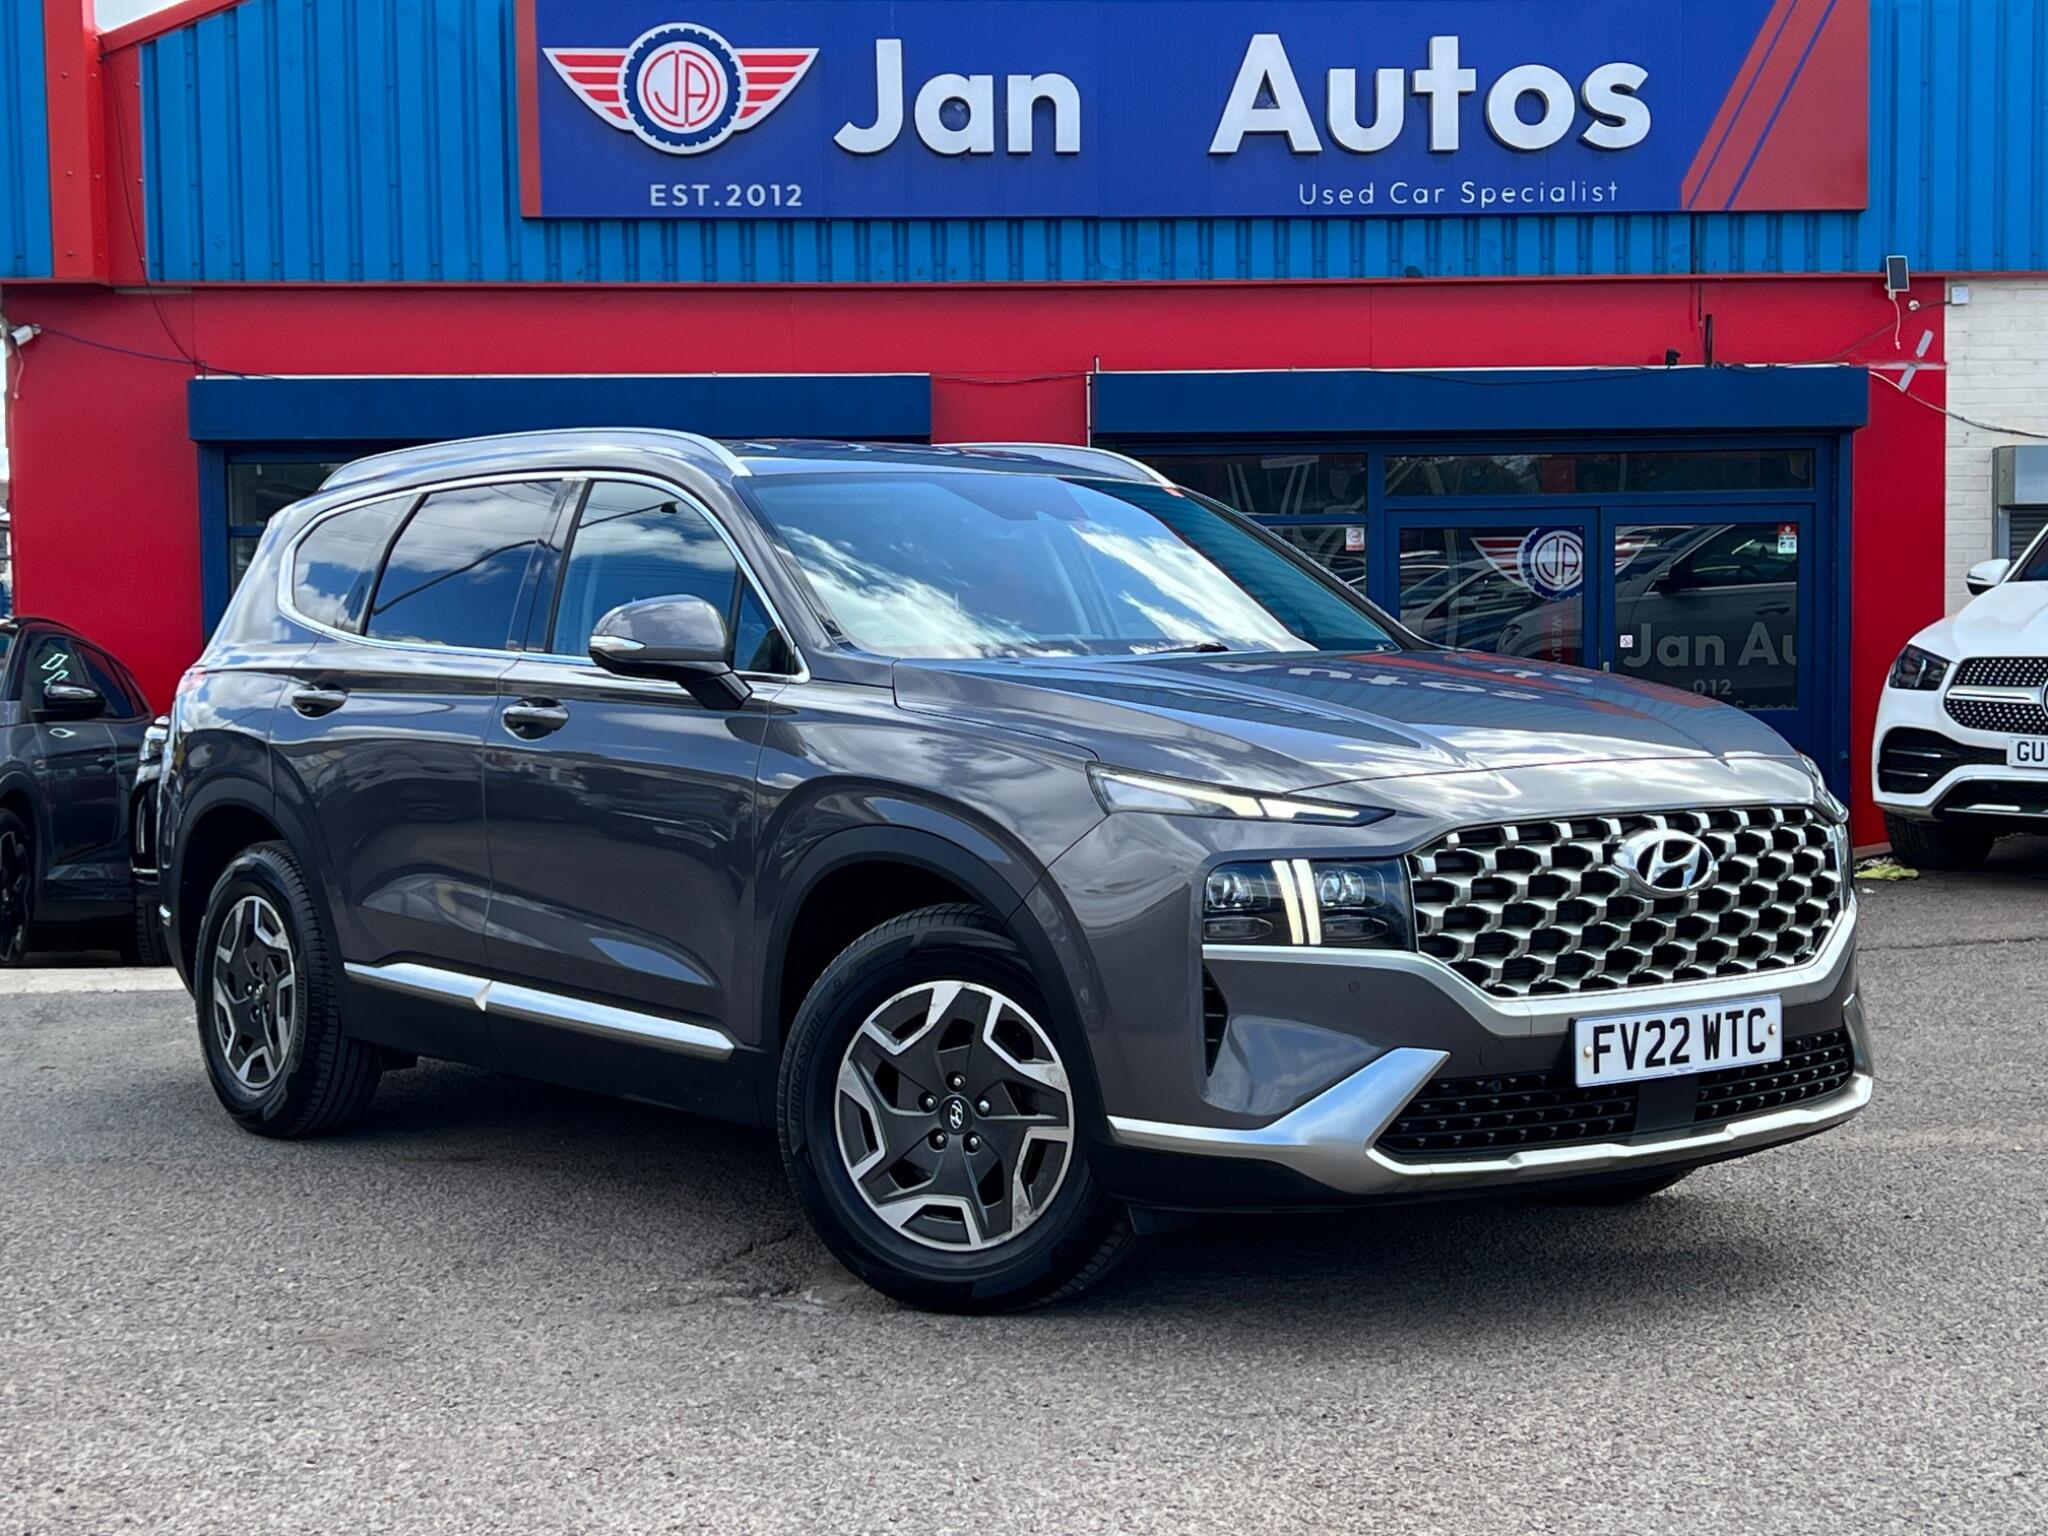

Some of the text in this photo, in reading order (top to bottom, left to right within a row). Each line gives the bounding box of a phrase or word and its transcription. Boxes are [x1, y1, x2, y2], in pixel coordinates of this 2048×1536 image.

[834, 33, 1651, 155] Jan Autos
[650, 184, 802, 207] EST.2012
[1299, 180, 1618, 208] Used Car Specialist
[1622, 623, 1725, 667] Jan
[2017, 741, 2048, 762] GU
[1593, 1008, 1766, 1074] FV22 WTC
[790, 1008, 825, 1133] BRIDGESTONE
